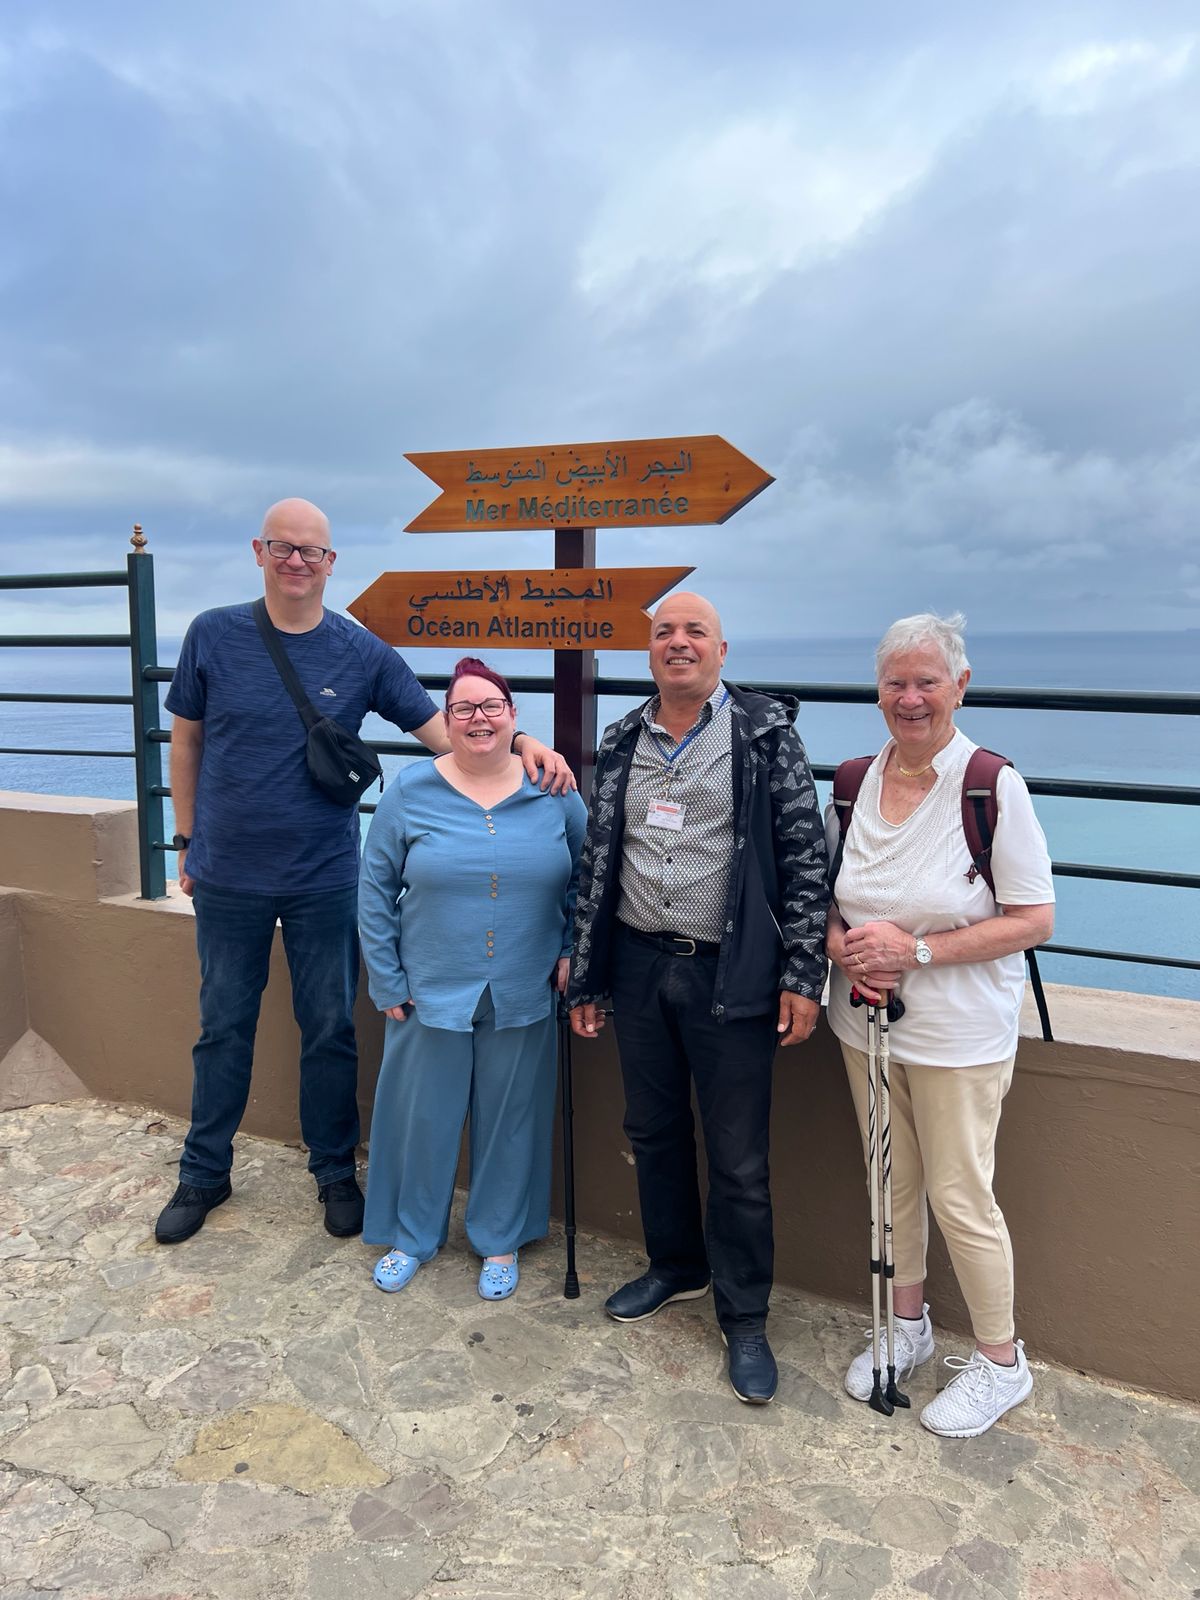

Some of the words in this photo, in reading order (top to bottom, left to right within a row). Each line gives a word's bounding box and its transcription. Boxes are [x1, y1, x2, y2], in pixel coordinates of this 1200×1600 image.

[464, 458, 546, 489] المتوسط
[555, 449, 628, 488] الأبيض
[639, 450, 692, 483] البحر
[465, 498, 511, 522] Mer
[518, 490, 689, 520] Méditerranée
[408, 574, 510, 613] الأطلسي
[520, 577, 613, 608] المحيط
[407, 614, 480, 638] Océan
[486, 615, 614, 644] Atlantique
